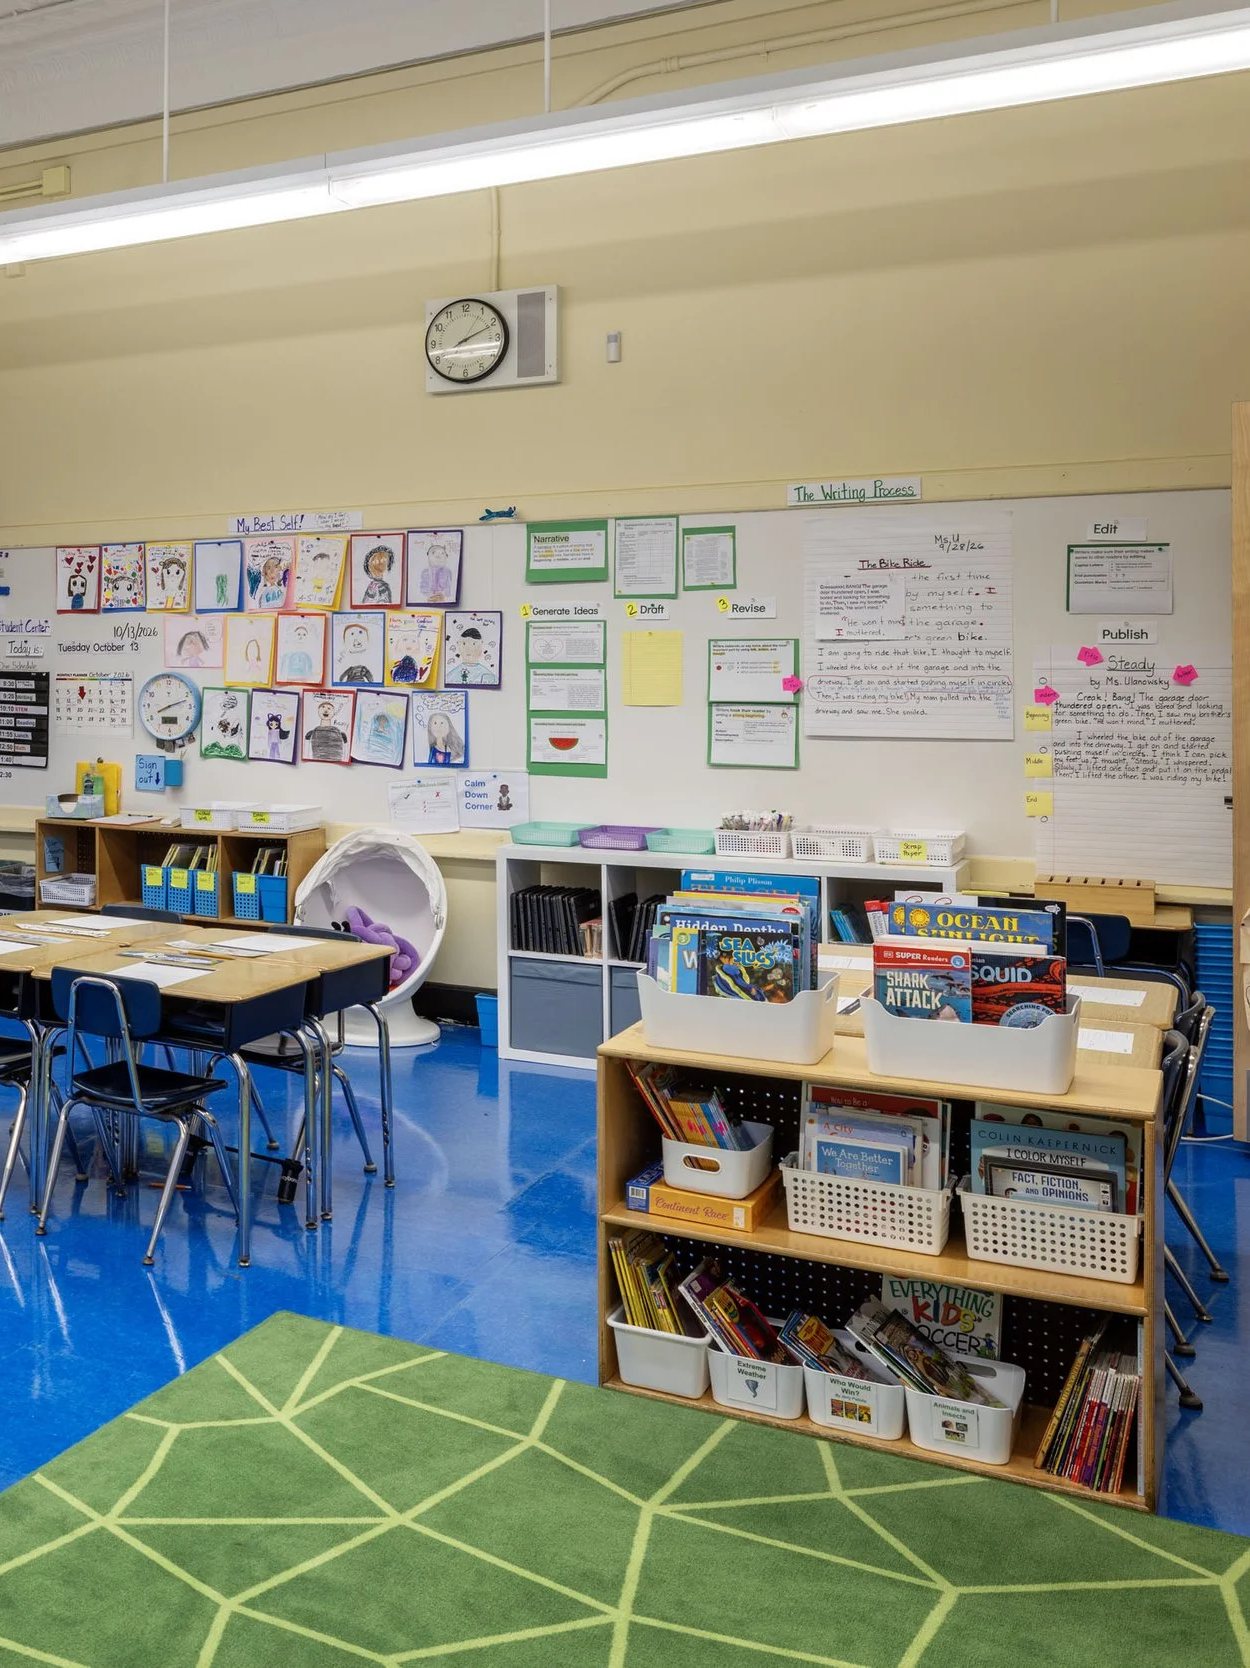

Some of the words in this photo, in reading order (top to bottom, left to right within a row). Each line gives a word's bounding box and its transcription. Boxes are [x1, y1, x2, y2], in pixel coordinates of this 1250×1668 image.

[462, 304, 470, 312] 12
[435, 324, 443, 332] 10
[490, 318, 496, 326] 2
[430, 340, 436, 348] 9
[495, 333, 500, 342] 3
[435, 356, 440, 364] 8
[448, 366, 452, 375] 7
[462, 368, 468, 377] 6
[479, 362, 484, 371] 5
[794, 486, 814, 501] The
[821, 482, 866, 503] Writing
[874, 480, 916, 498] Process
[237, 518, 250, 535] My
[254, 516, 275, 531] Best
[280, 515, 304, 531] Self!
[1094, 524, 1118, 534] Edit
[534, 535, 570, 543] Narrative
[939, 540, 984, 553] 9/28/26
[859, 560, 876, 569] The
[879, 559, 900, 568] Bike
[903, 558, 926, 568] Ride
[912, 572, 930, 580] the
[936, 572, 961, 580] first
[968, 572, 990, 580] time
[628, 605, 637, 616] 2
[640, 605, 664, 614] Draft
[718, 599, 728, 609] 3
[732, 604, 766, 614] Revise
[910, 602, 972, 615] something
[522, 606, 530, 616] 1
[532, 606, 570, 616] Generate
[574, 606, 598, 616] Ideas
[25, 620, 50, 633] Center
[910, 618, 930, 626] the
[113, 622, 158, 640] 10/13/2026
[1102, 629, 1148, 640] Publish
[8, 640, 30, 656] Today
[58, 643, 90, 653] Tuesday
[93, 642, 125, 652] October
[130, 642, 138, 651] 13
[1107, 655, 1155, 678] Steady
[1090, 677, 1100, 689] by
[1106, 677, 1122, 686] Ms.
[1124, 677, 1170, 690] Ulanowsky
[1139, 692, 1154, 701] The
[1159, 694, 1186, 704] garage
[1055, 701, 1094, 709] thundered
[1196, 702, 1223, 712] looking
[1190, 736, 1216, 744] garage
[138, 758, 158, 774] Sign
[138, 774, 153, 784] out
[464, 791, 488, 799] Down
[465, 802, 493, 810] Corner
[903, 850, 922, 858] Paper
[904, 843, 922, 852] Scrap
[725, 876, 746, 886] Philip
[748, 877, 772, 886] Plisson
[676, 920, 728, 930] Hidden
[734, 923, 784, 933] Depths
[936, 914, 1019, 932] OCEAN
[720, 937, 756, 952] SEA
[732, 950, 776, 969] SLUGS
[895, 952, 922, 960] SUPER
[922, 954, 948, 963] Readers
[886, 971, 930, 990] SHARK
[971, 965, 1032, 983] SQUID
[886, 987, 943, 1010] ATTACK
[1006, 1004, 1042, 1018] SEARCHING
[978, 1130, 1022, 1143] COLIN
[1028, 1136, 1117, 1155] KAEPERNICK
[822, 1146, 838, 1158] We
[839, 1149, 858, 1160] Are
[861, 1152, 894, 1166] Better
[1015, 1150, 1047, 1162] COLOR
[1050, 1154, 1086, 1167] MYSELF
[835, 1157, 880, 1173] Together
[1026, 1188, 1039, 1196] AND
[1042, 1187, 1088, 1202] OPINIONS
[654, 1196, 700, 1216] Continent
[702, 1207, 730, 1221] Race
[890, 1280, 994, 1320] EVERYTHING
[917, 1324, 981, 1352] OCCER
[737, 1360, 767, 1372] Extreme
[737, 1368, 767, 1380] Weather
[830, 1377, 846, 1388] Who
[848, 1380, 872, 1392] Would
[841, 1386, 860, 1396] Win?
[934, 1402, 961, 1412] Animals
[962, 1407, 976, 1415] and
[942, 1410, 966, 1420] Insects
